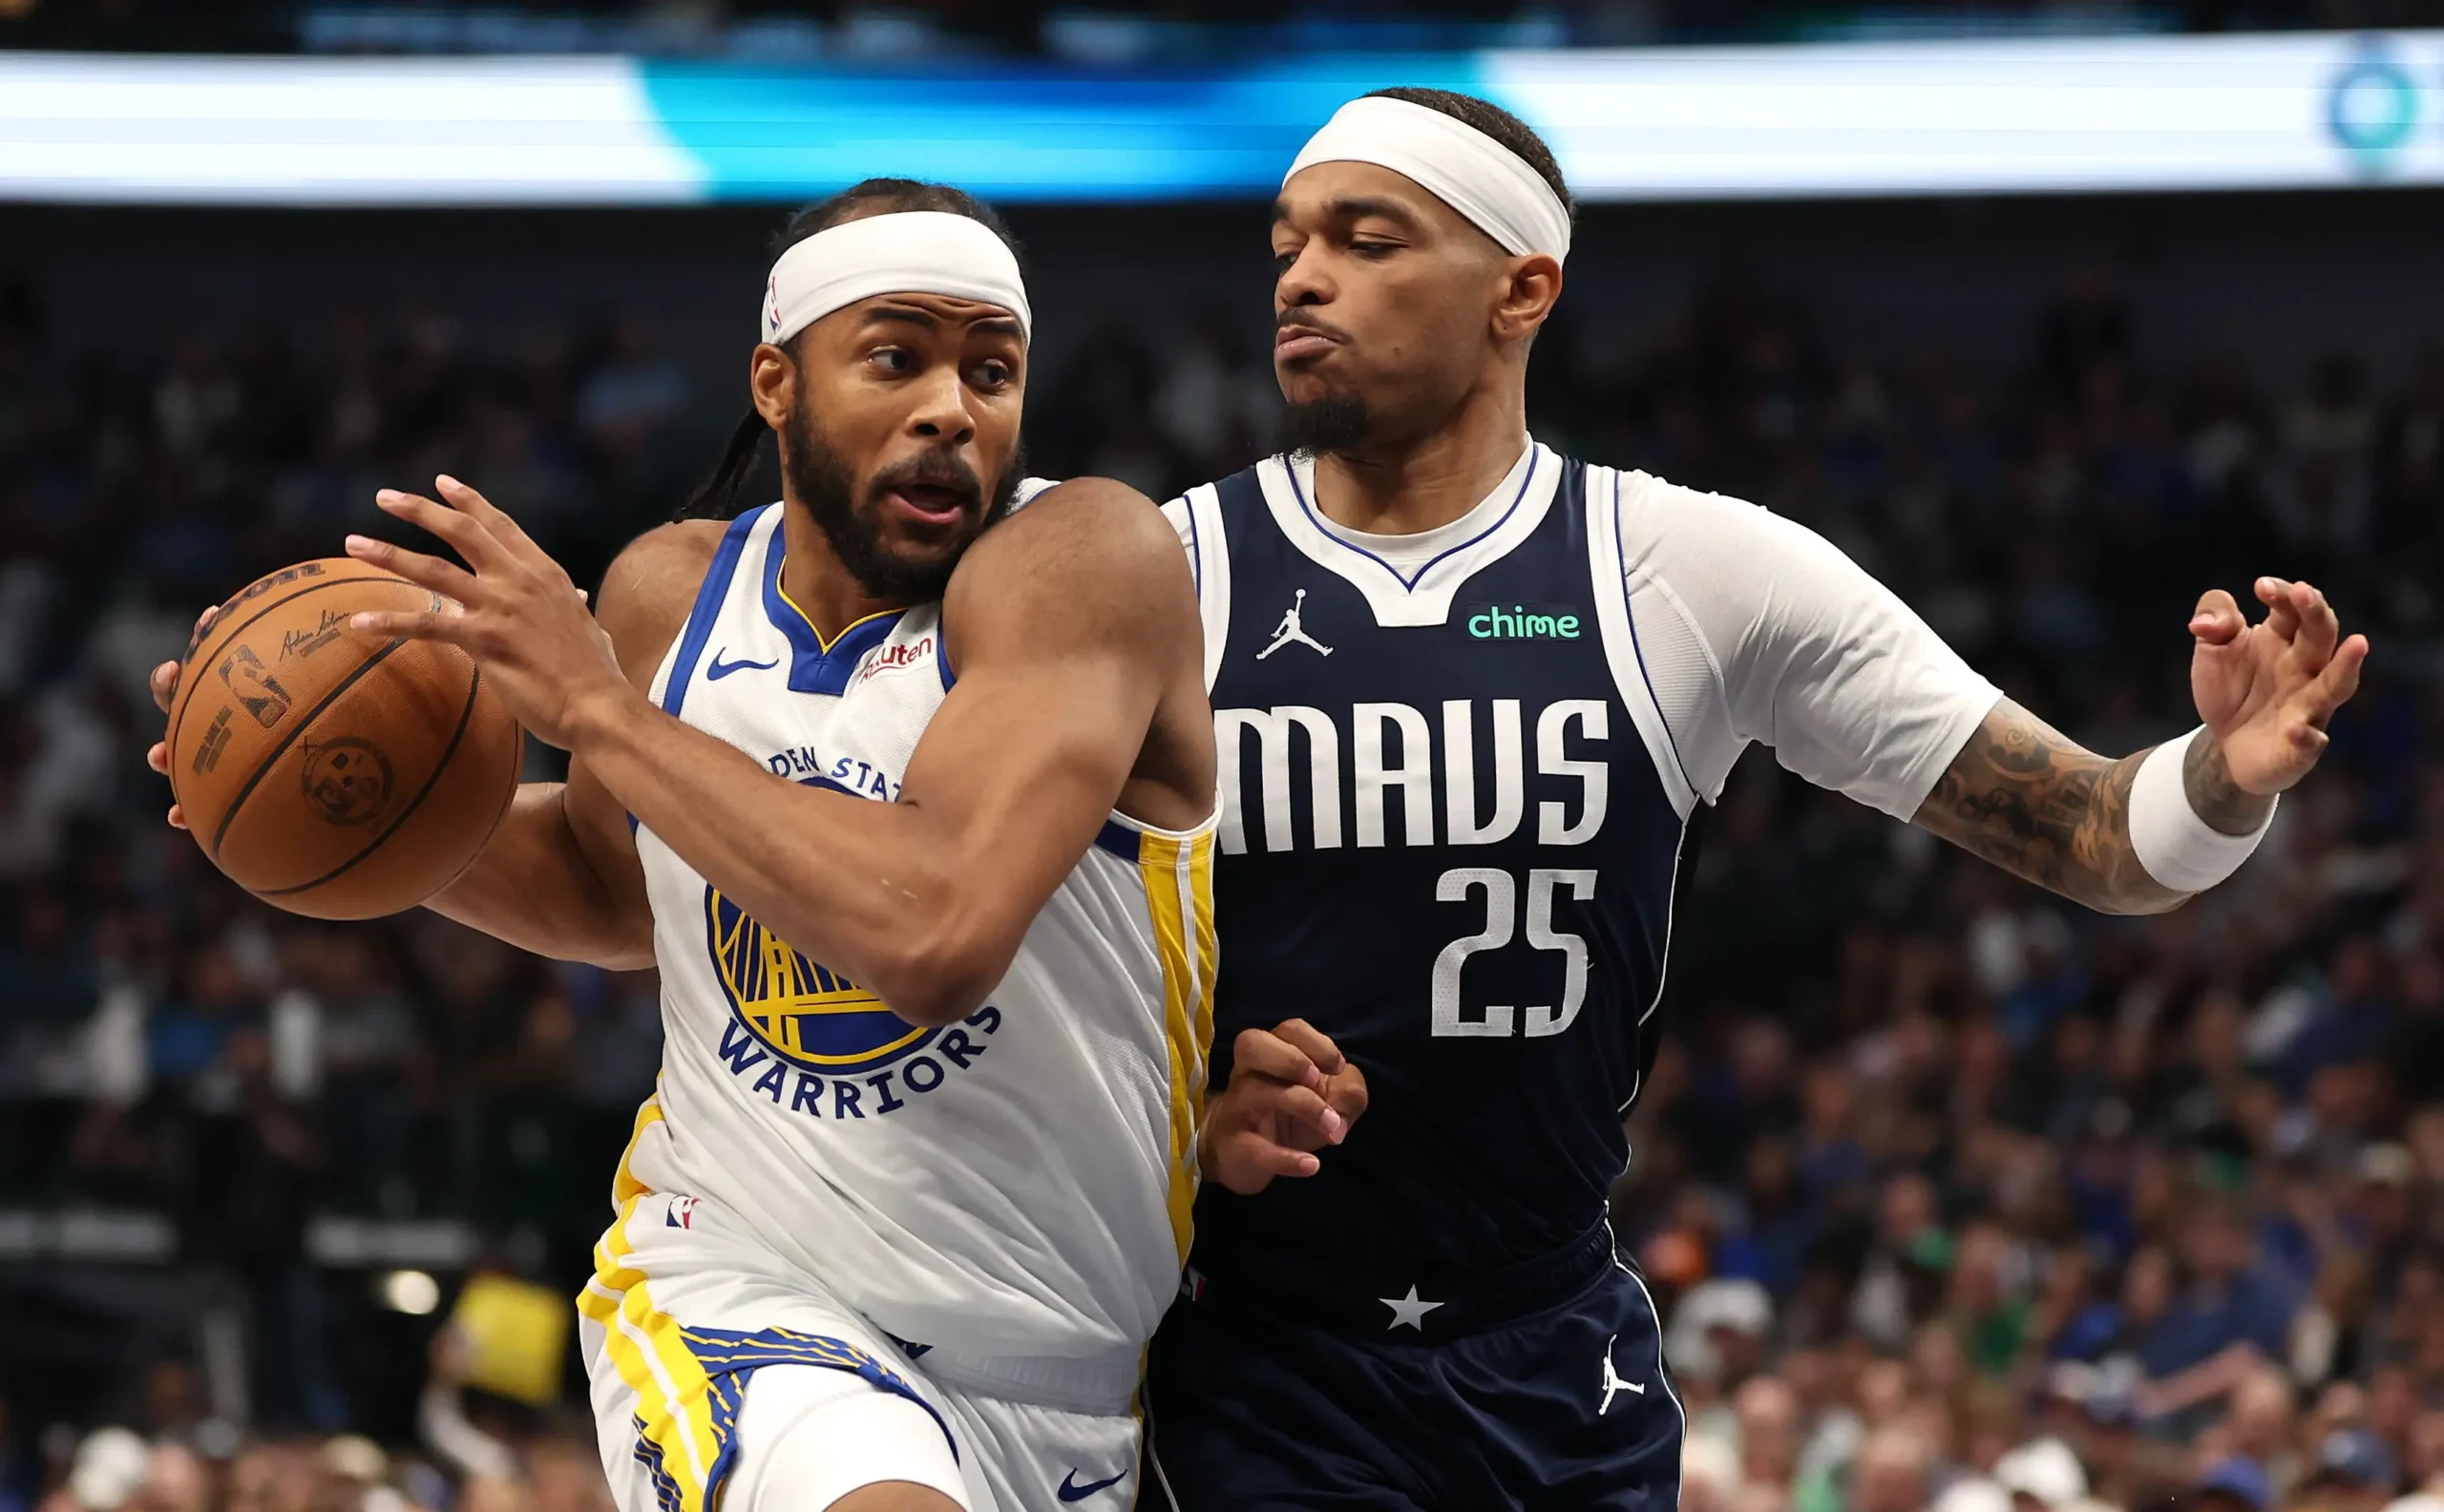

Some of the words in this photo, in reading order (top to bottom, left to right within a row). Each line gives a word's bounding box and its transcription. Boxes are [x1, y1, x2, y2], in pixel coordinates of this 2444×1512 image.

[860, 638, 932, 683] uten
[1468, 605, 1581, 639] chime
[768, 746, 820, 778] DEN
[831, 757, 901, 803] STAT
[1213, 699, 1610, 854] MAVS
[1431, 867, 1598, 1038] 25
[717, 1005, 1001, 1120] WARRIORS
